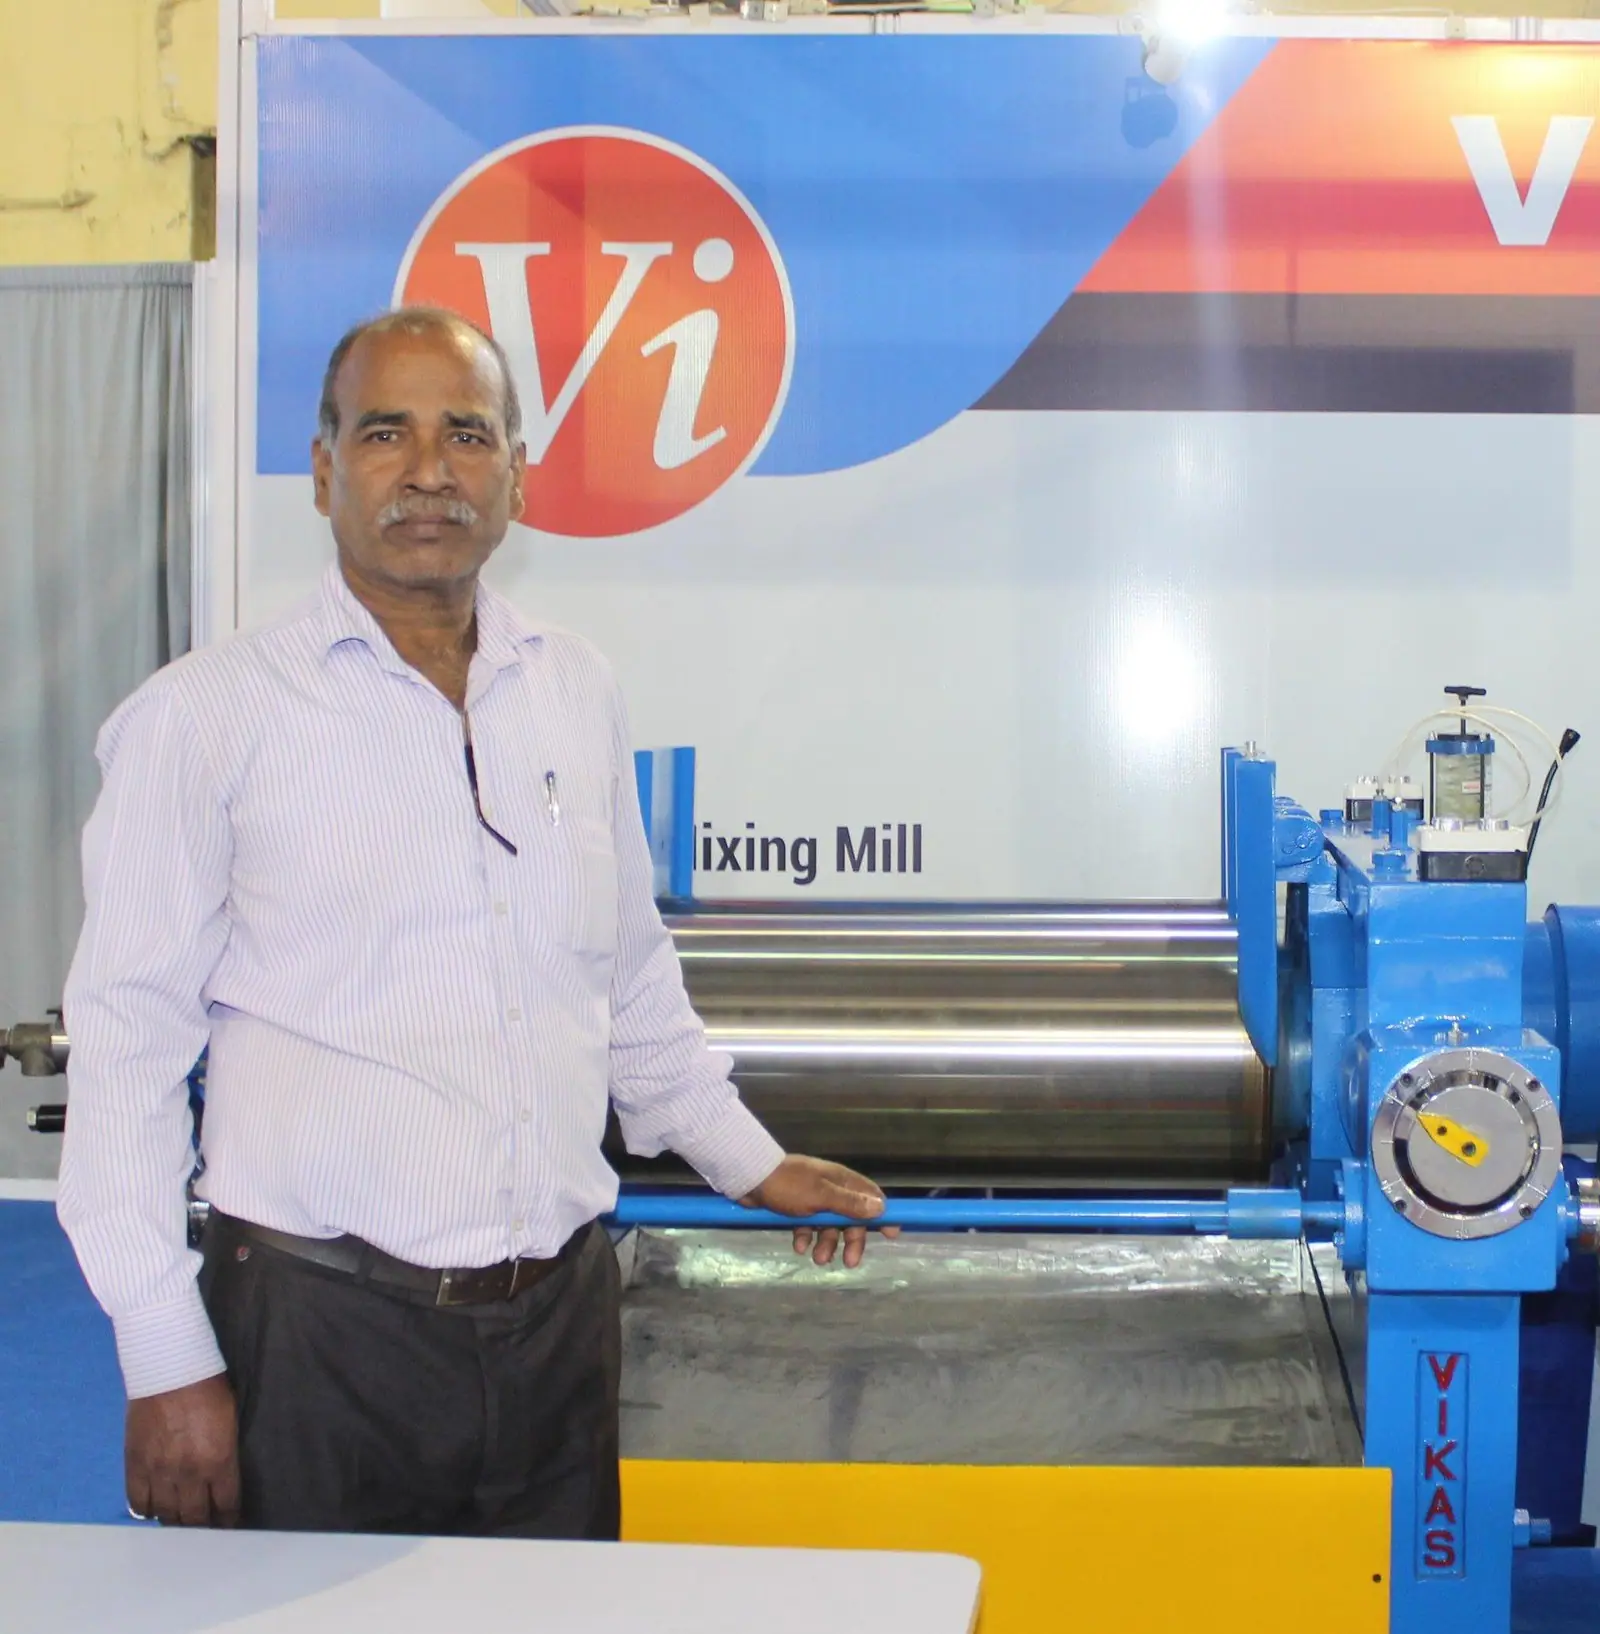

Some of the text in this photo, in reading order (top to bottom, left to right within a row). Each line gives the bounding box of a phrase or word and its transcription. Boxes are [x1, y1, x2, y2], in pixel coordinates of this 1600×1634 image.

[1450, 114, 1595, 246] V
[454, 237, 735, 470] Vi
[693, 822, 922, 886] ixing Mill
[1423, 1354, 1460, 1569] VIKAS
